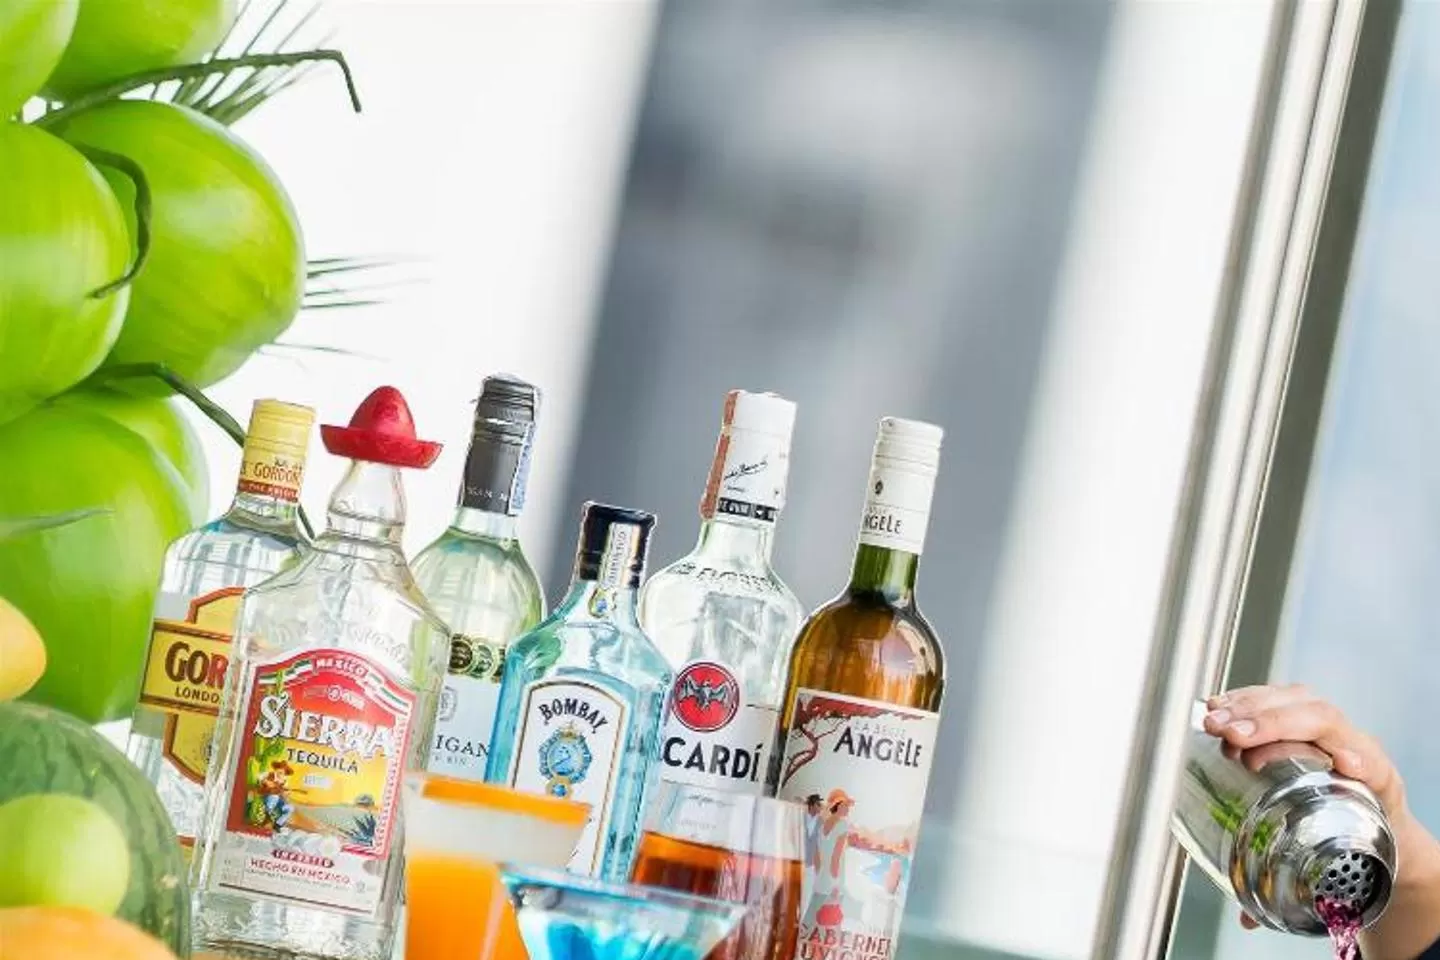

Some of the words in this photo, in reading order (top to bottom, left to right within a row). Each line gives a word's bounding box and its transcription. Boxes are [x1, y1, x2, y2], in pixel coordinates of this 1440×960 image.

[174, 685, 220, 704] LONDO
[252, 690, 398, 764] SIERRA
[538, 697, 609, 735] BOMBAY
[286, 748, 359, 775] TEQUILA
[662, 736, 764, 783] CARDÍ
[250, 858, 290, 874] HECHO
